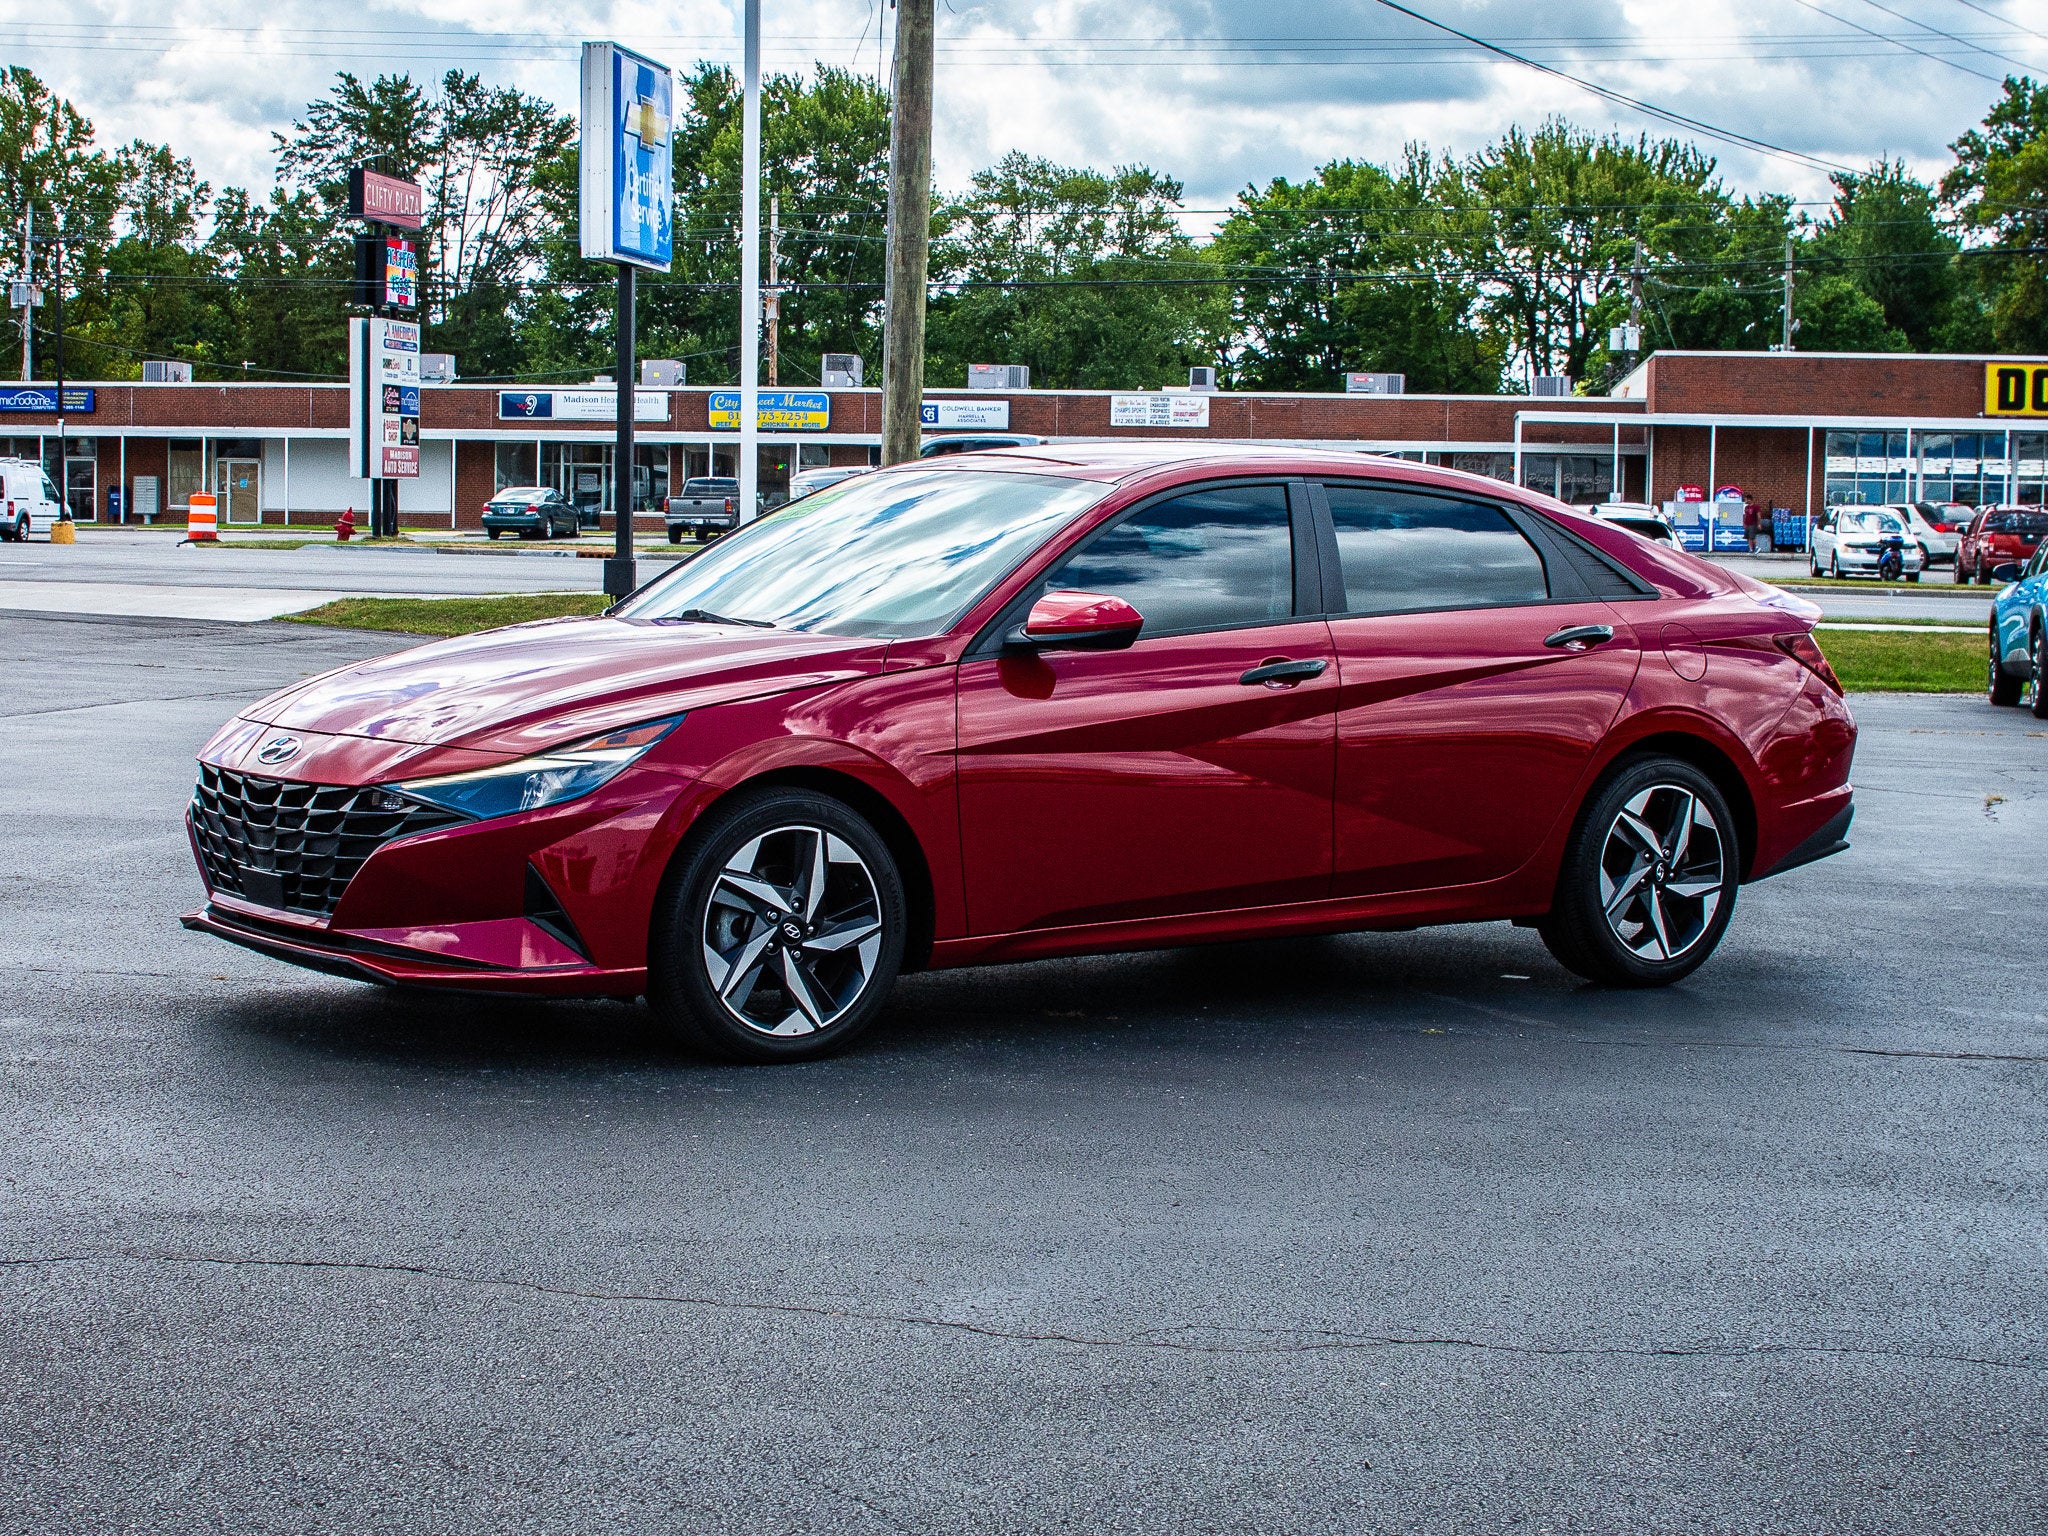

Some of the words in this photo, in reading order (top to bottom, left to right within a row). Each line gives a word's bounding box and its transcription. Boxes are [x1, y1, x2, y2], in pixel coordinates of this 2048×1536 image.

[366, 183, 392, 211] CLIFTY
[395, 191, 419, 215] PLAZA
[0, 394, 51, 406] microdome
[563, 396, 599, 404] Madison
[714, 395, 740, 410] City
[758, 397, 776, 406] eat
[779, 394, 823, 409] Market
[389, 449, 413, 460] MADISON
[384, 460, 398, 473] AUTO
[397, 460, 418, 474] SERVICE
[884, 871, 902, 935] KUMHO
